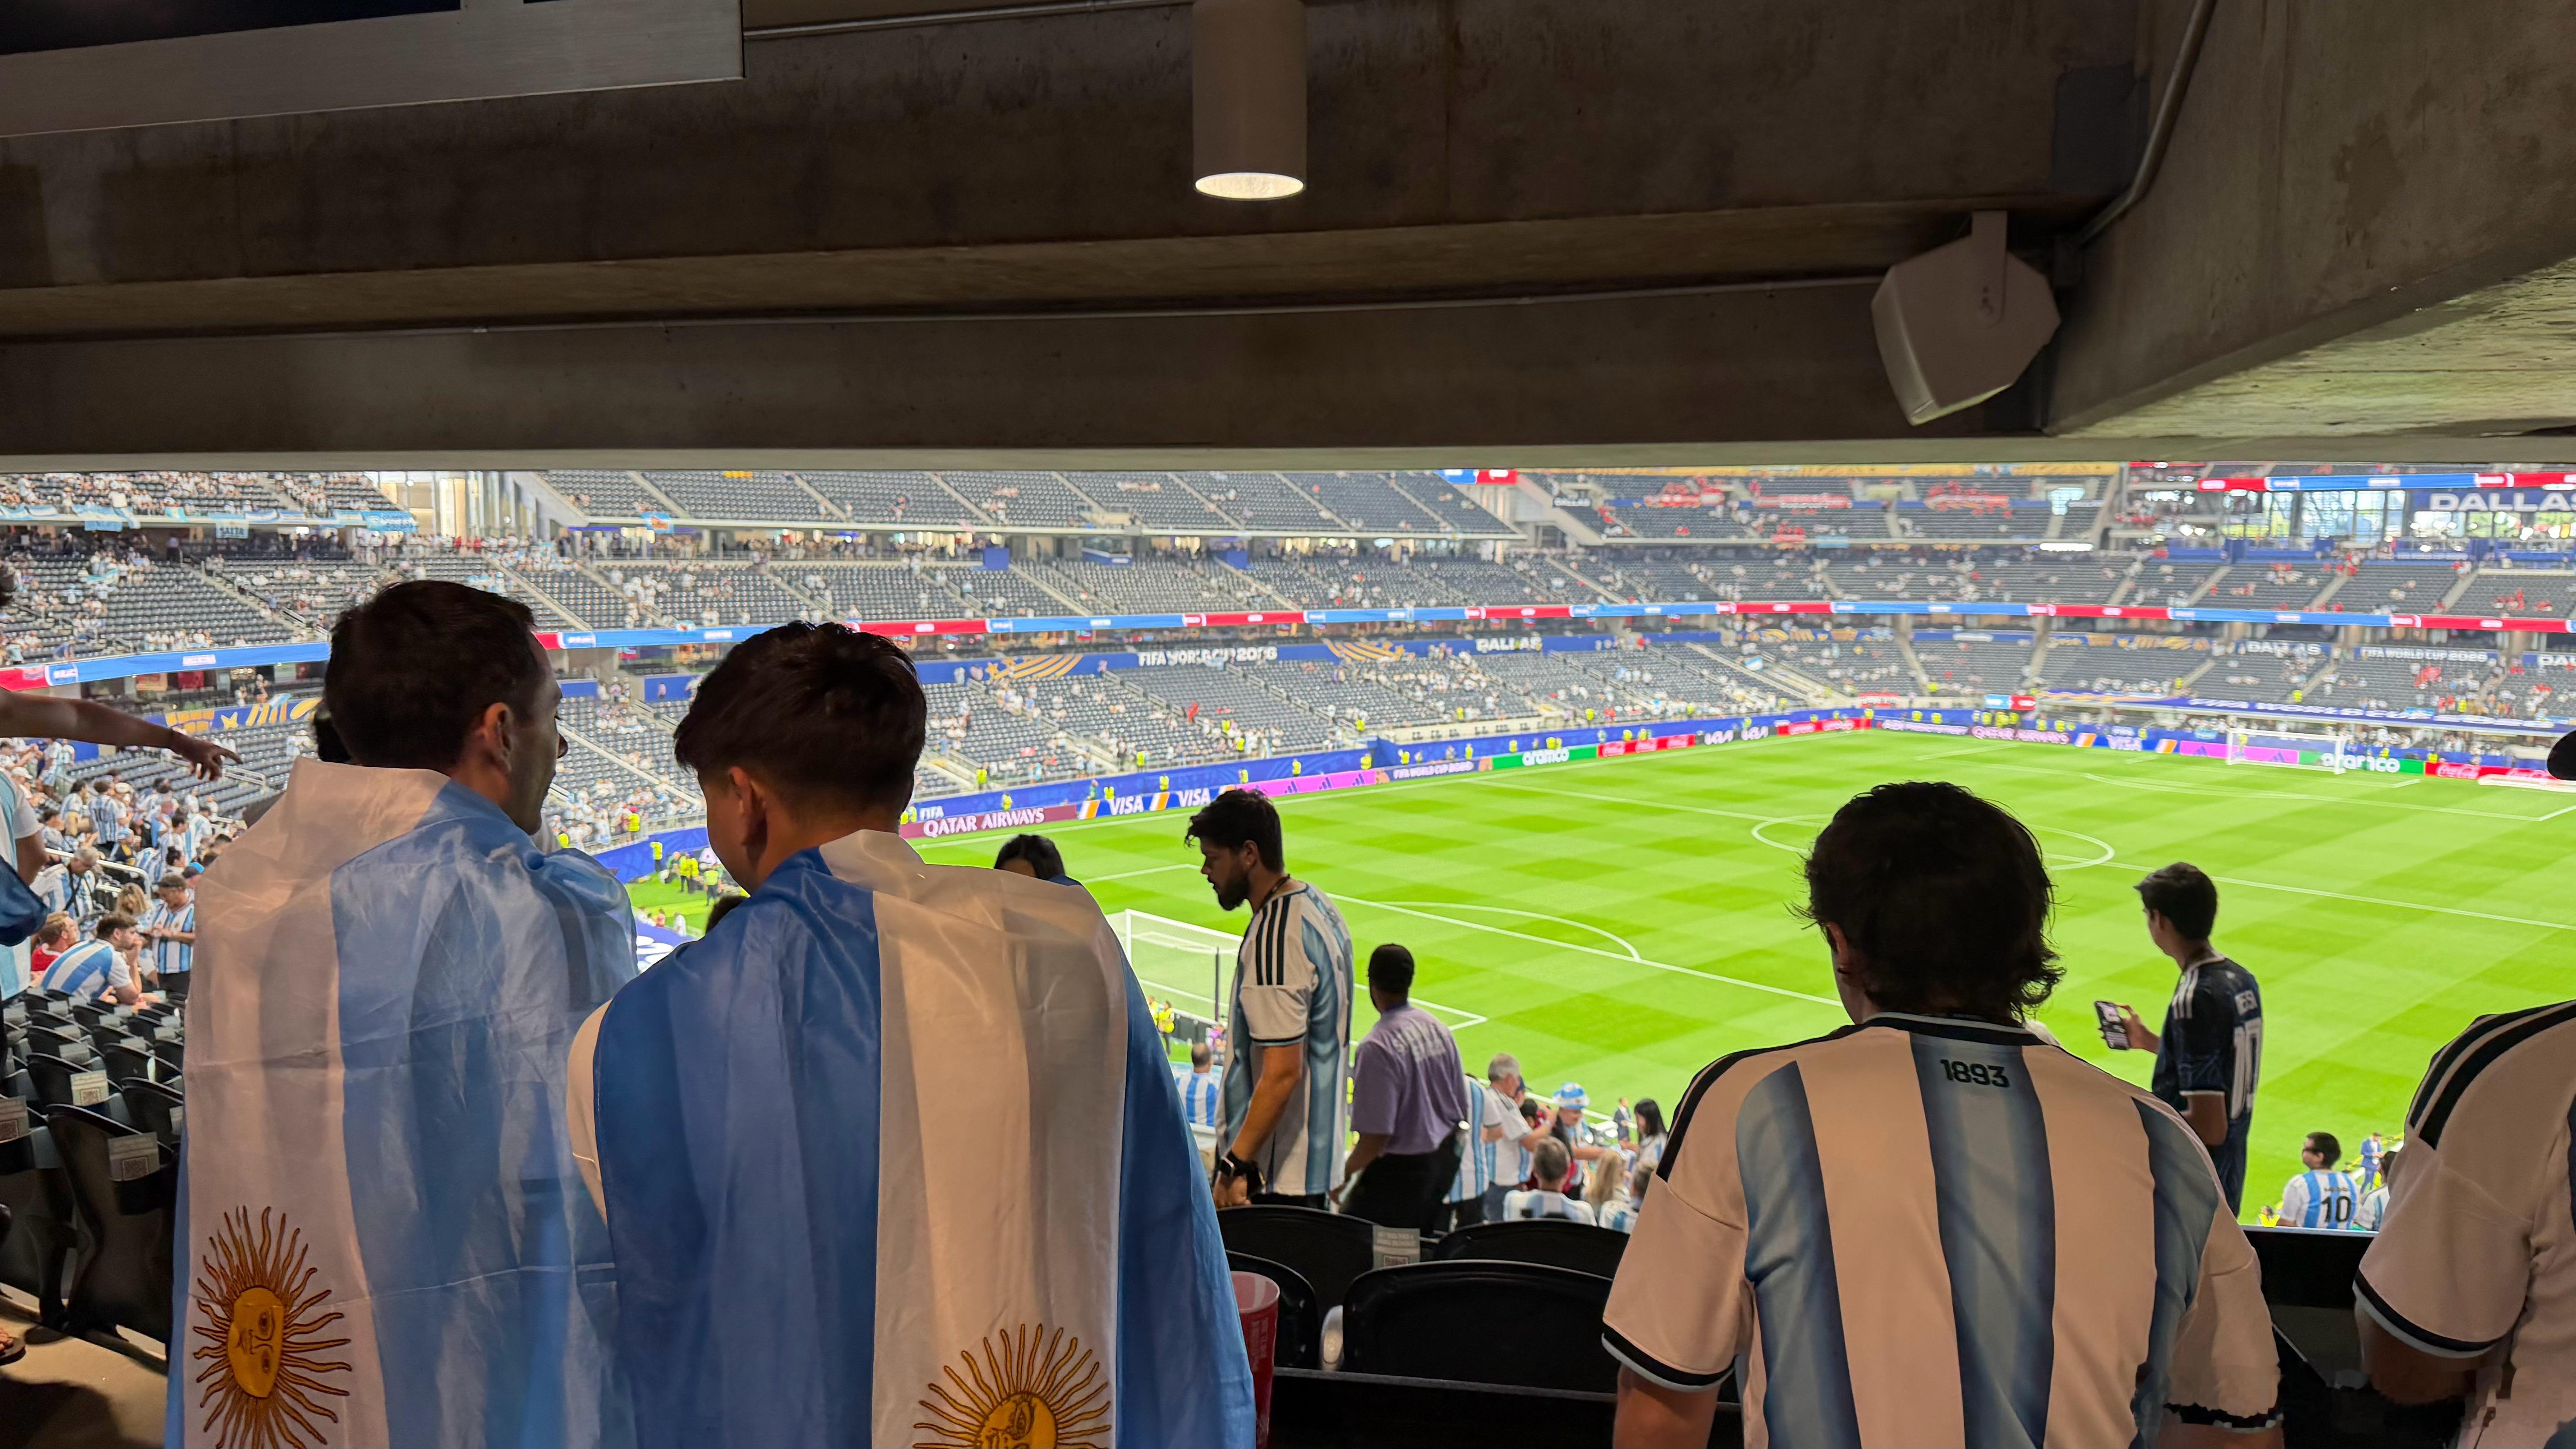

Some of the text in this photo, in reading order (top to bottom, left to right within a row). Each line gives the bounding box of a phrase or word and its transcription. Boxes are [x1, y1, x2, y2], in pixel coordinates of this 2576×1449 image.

[2430, 493, 2576, 512] DALLA
[2246, 640, 2322, 655] DAAS
[2385, 648, 2424, 659] WORLD
[2424, 649, 2448, 660] CUP
[1138, 651, 1167, 667] FIFA
[2255, 702, 2364, 716] WORLD
[2107, 735, 2143, 751] VISA
[1522, 748, 1569, 766] aramco
[1109, 795, 1144, 815] VISA
[1178, 788, 1212, 807] VISA
[920, 805, 944, 821] FIFA
[923, 807, 1044, 838] QATAR AIRWAYS
[1939, 1059, 2010, 1088] 1893
[2321, 1195, 2352, 1223] 10
